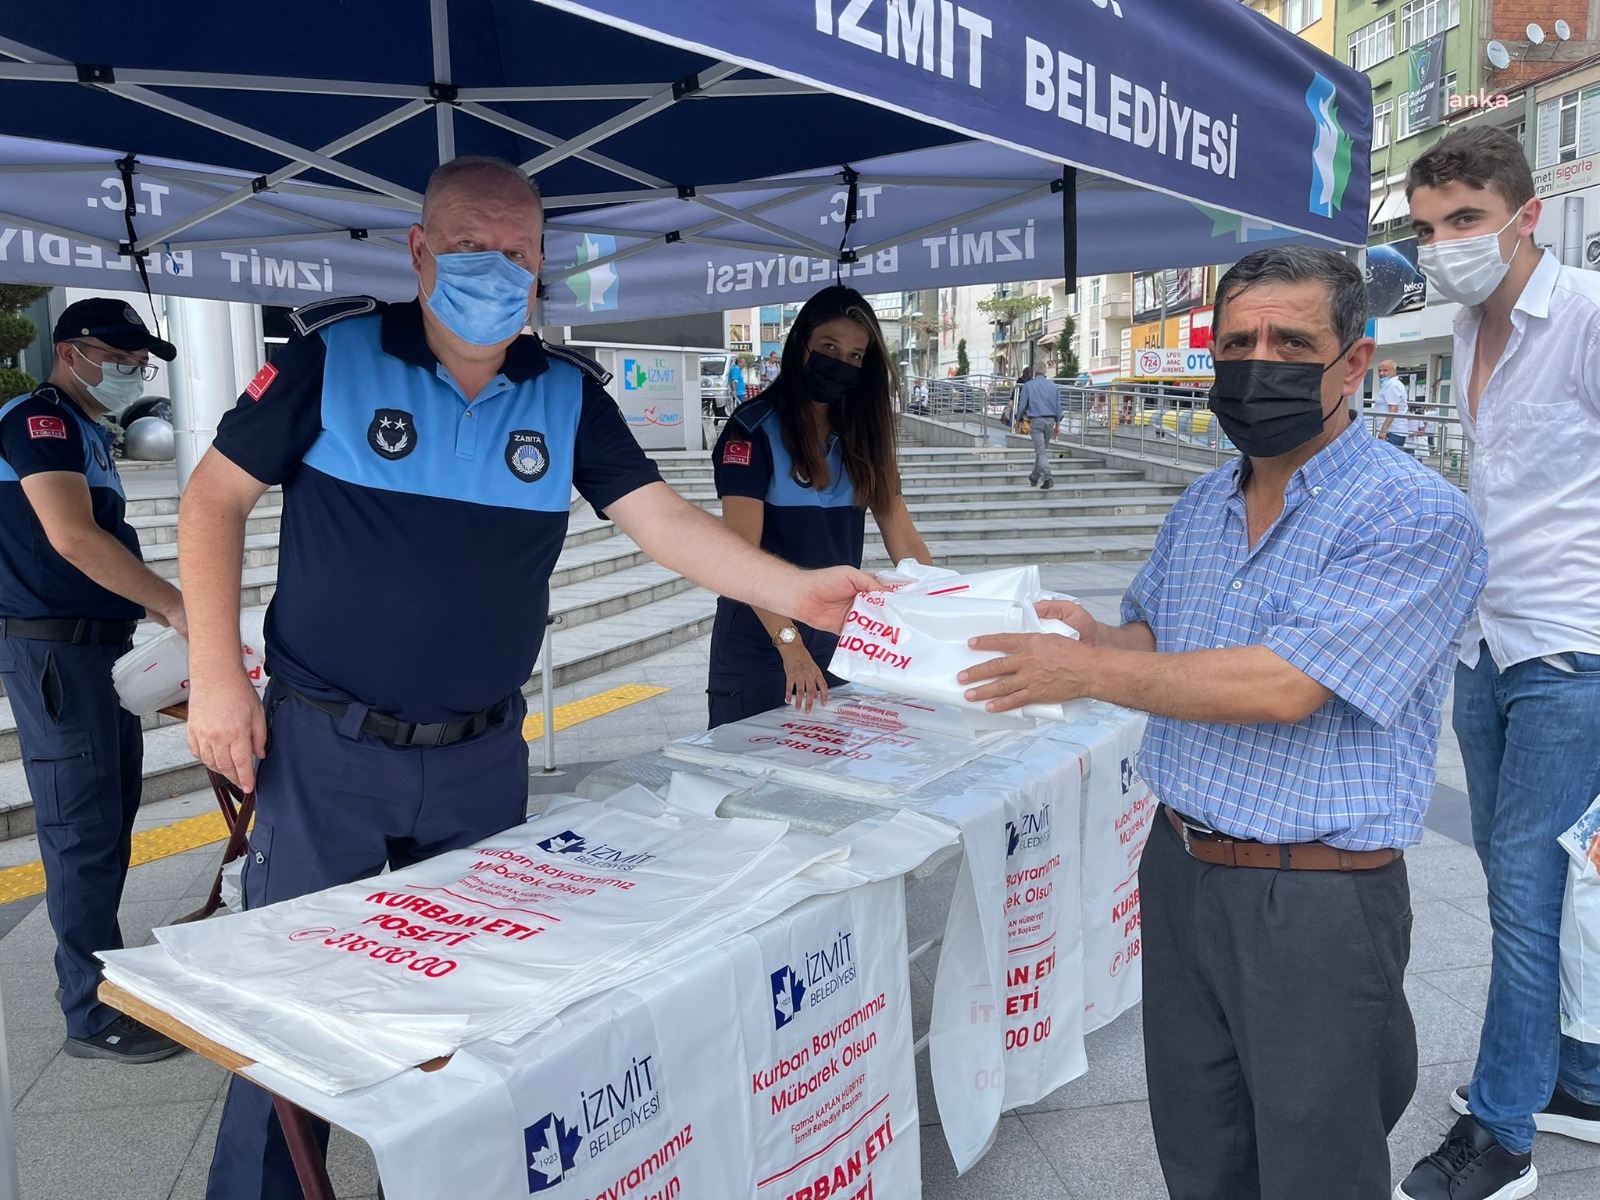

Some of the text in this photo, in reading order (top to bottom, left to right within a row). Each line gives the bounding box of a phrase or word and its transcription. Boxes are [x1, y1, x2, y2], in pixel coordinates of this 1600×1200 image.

[1025, 36, 1238, 180] BELEDİYESİ
[1556, 160, 1593, 181] sigorta
[647, 366, 676, 383] İZMİT
[1020, 803, 1050, 838] ZMİT
[469, 861, 546, 887] Mbarek
[586, 843, 657, 865] İZMİT
[361, 913, 478, 947] POŞETİ
[365, 891, 546, 941] KURBAN ETİ
[407, 956, 458, 978] 00
[805, 931, 852, 988] İZMİT
[1034, 945, 1056, 981] ETİ
[810, 962, 857, 1008] BELEDİYESİ
[752, 992, 887, 1095] Kurban Bayramımız
[580, 1054, 653, 1135] İZMİT
[770, 1031, 878, 1116] Mübarek Olsun
[589, 1090, 661, 1159] BELEDİYESİ
[790, 1072, 866, 1134] Fatma KAPLAN HÜRRİYET
[794, 1127, 812, 1145] İzmit
[812, 1107, 841, 1134] Belediye
[539, 1151, 559, 1169] 1923
[588, 1123, 694, 1200] ayramımız
[865, 1112, 894, 1166] ETİ
